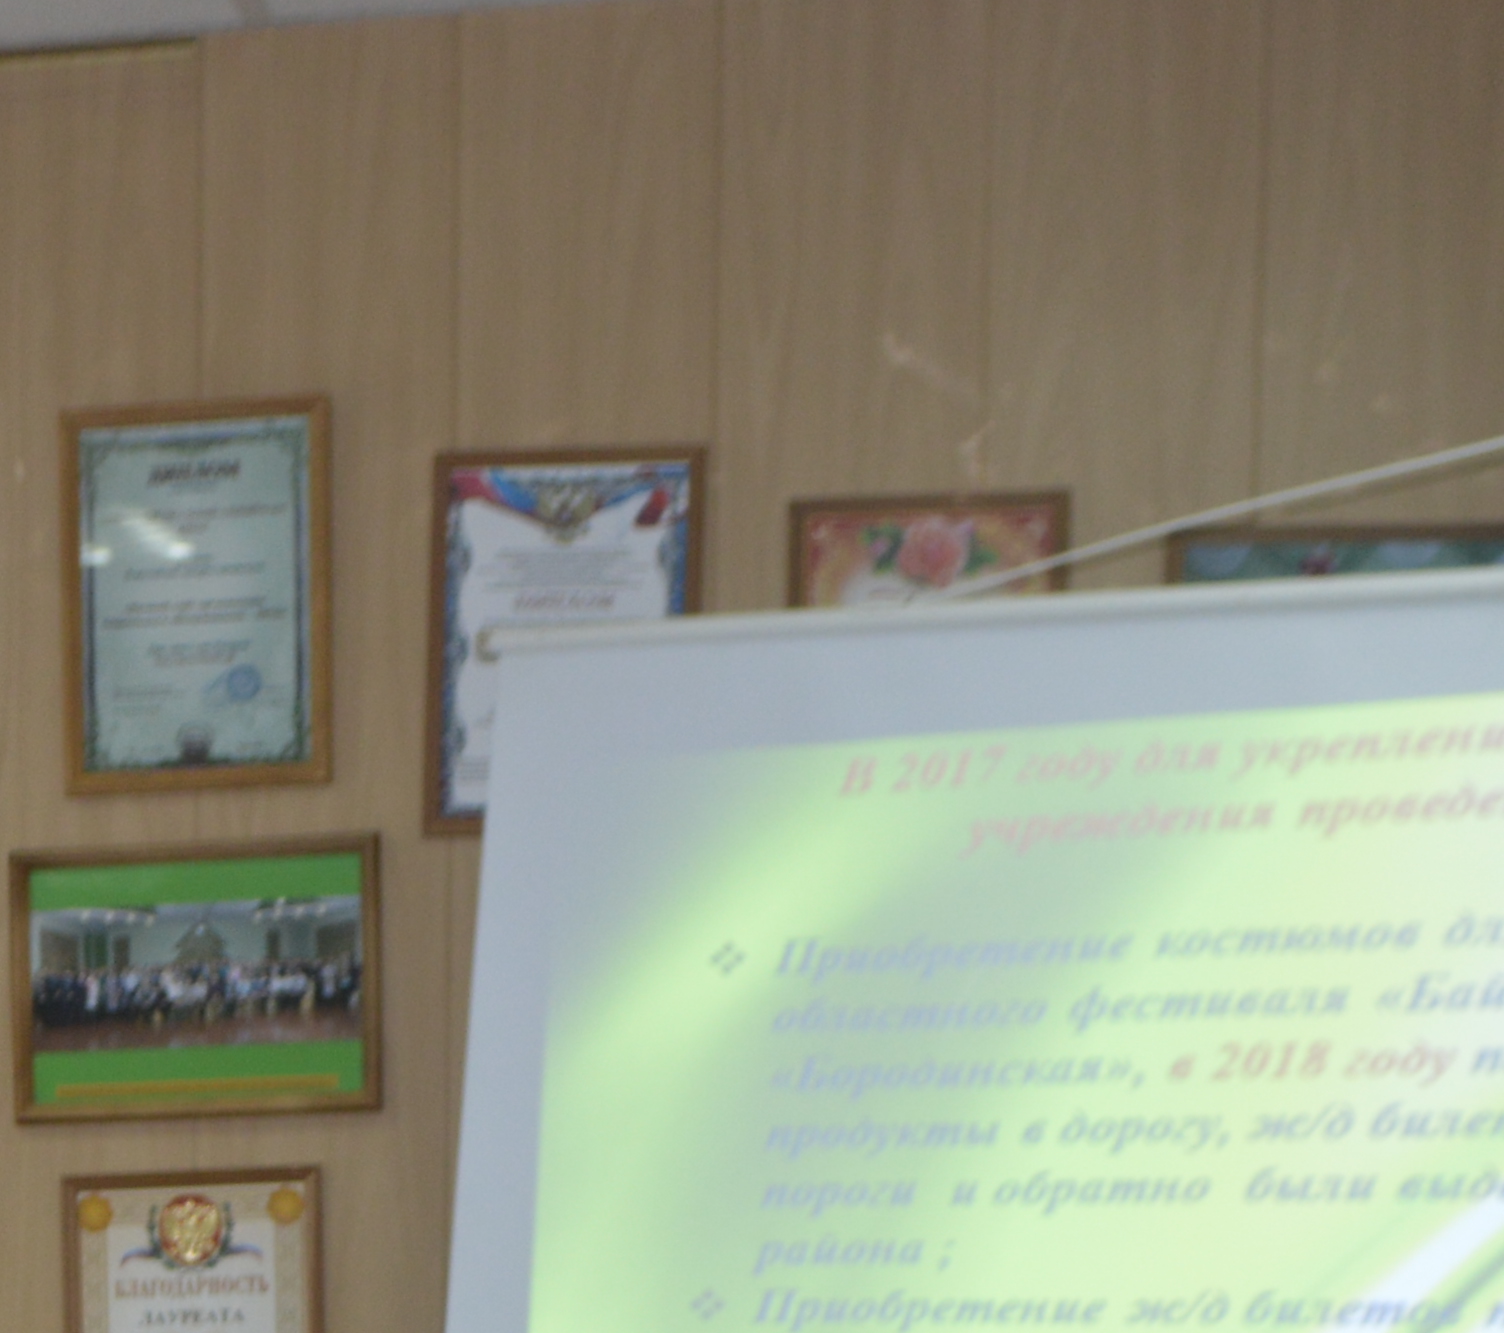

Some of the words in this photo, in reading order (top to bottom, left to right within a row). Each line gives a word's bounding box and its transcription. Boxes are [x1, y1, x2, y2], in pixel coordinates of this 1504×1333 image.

[839, 755, 876, 798] В
[889, 744, 1007, 793] 2017
[1016, 744, 1120, 788] году
[1133, 733, 1221, 775] для
[959, 800, 1276, 859] учреждения
[775, 930, 1134, 979] Приобретение
[1154, 919, 1422, 959] костюмов
[769, 1055, 1148, 1099] «Бородинская»,
[1166, 1053, 1193, 1084] в
[1209, 1038, 1334, 1084] 2018
[1342, 1040, 1460, 1088] году
[763, 1115, 1000, 1160] продукты
[1020, 1119, 1045, 1147] в
[1059, 1106, 1233, 1153] дорогу,
[1246, 1102, 1355, 1142] ж/д
[759, 1174, 918, 1217] пороги
[952, 1177, 980, 1207] и
[995, 1169, 1212, 1216] обратно
[1244, 1167, 1377, 1203] были
[115, 1274, 269, 1299] БЛАГОДАРНОСТЬ
[751, 1285, 1107, 1331] Приобретение
[1123, 1288, 1231, 1328] ж/д
[1244, 1289, 1462, 1328] билетов
[139, 1308, 245, 1325] ЛАУРЕАТА
